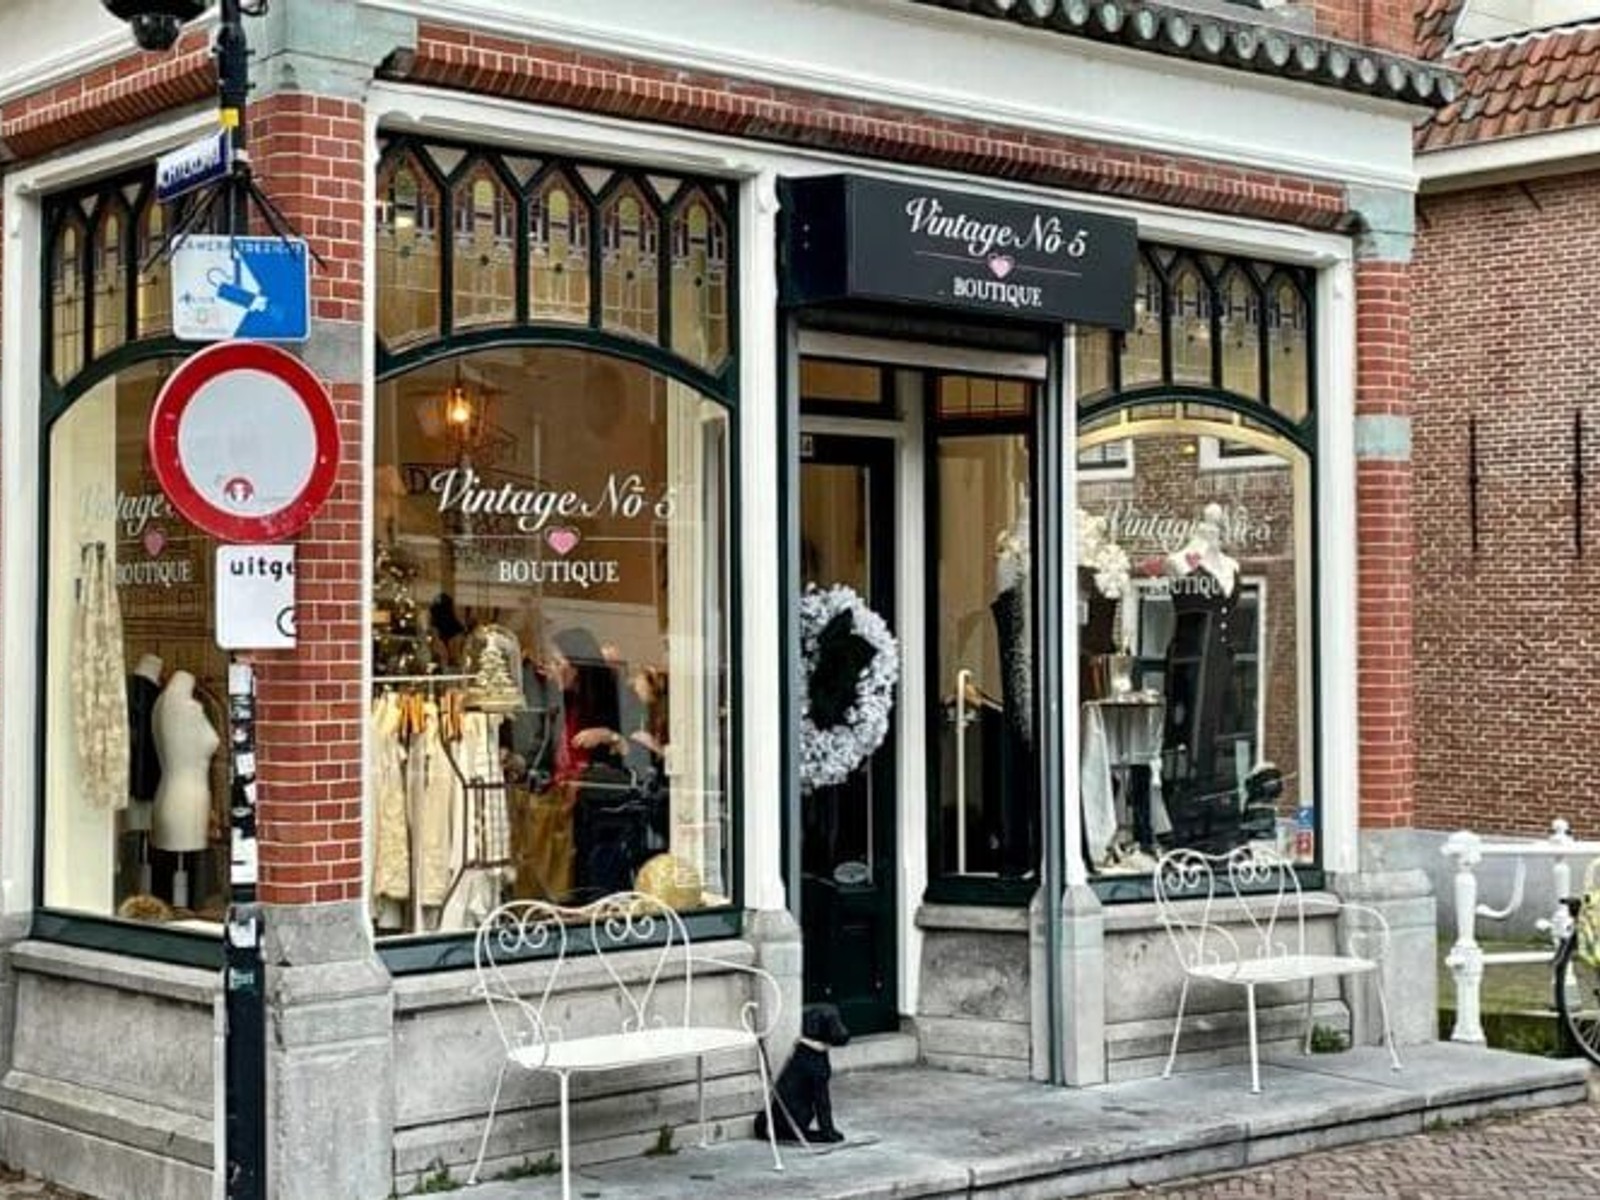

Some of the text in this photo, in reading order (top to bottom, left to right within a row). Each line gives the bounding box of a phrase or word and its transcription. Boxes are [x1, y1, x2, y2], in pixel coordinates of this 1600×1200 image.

[905, 197, 1013, 257] Vintage
[1066, 230, 1089, 258] 5
[953, 276, 1043, 308] BOUTIQUE
[429, 467, 578, 532] Vintage
[499, 560, 620, 587] BOUTIQUE
